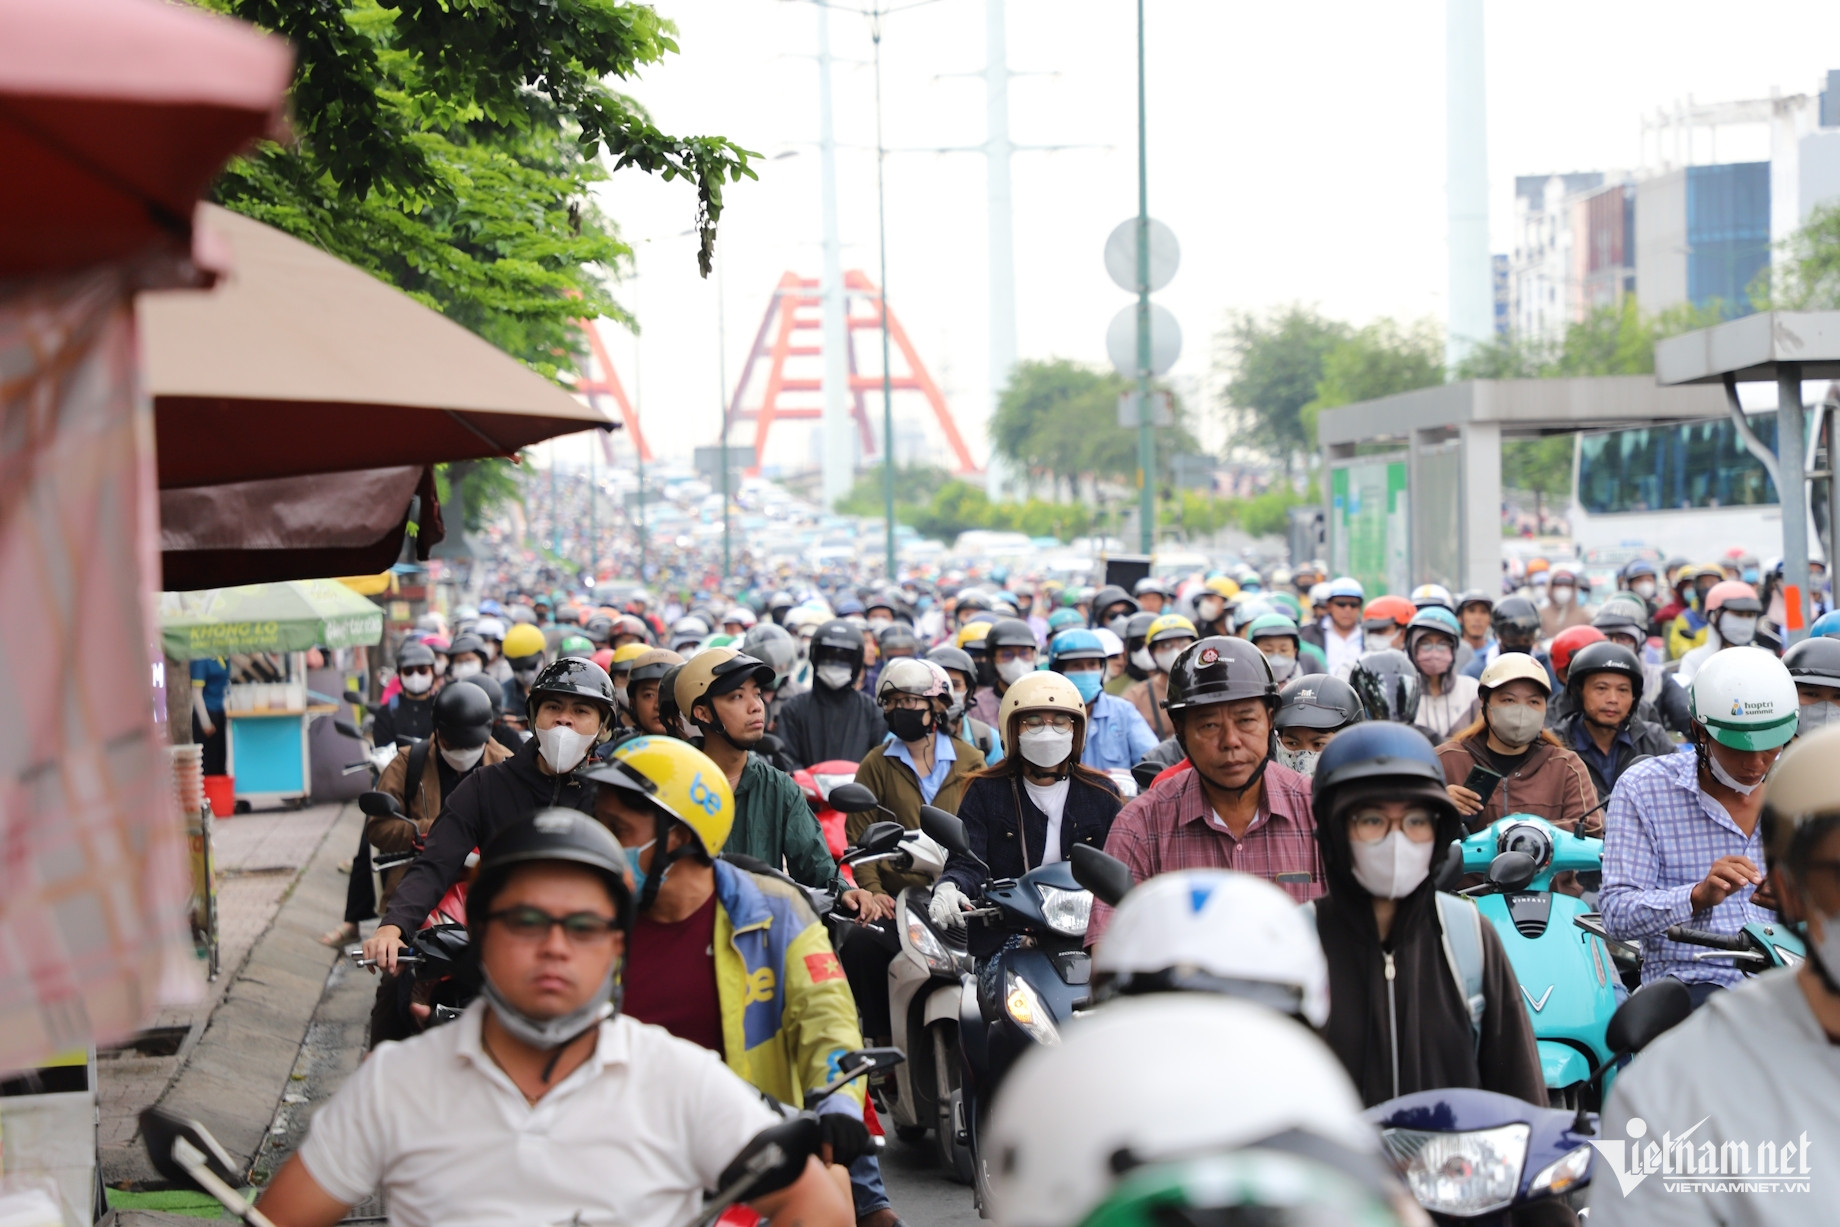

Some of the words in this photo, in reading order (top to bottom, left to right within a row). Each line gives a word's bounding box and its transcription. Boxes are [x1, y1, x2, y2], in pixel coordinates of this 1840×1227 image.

[1744, 701, 1774, 710] hoptri
[1745, 708, 1774, 716] summit
[689, 771, 722, 817] be
